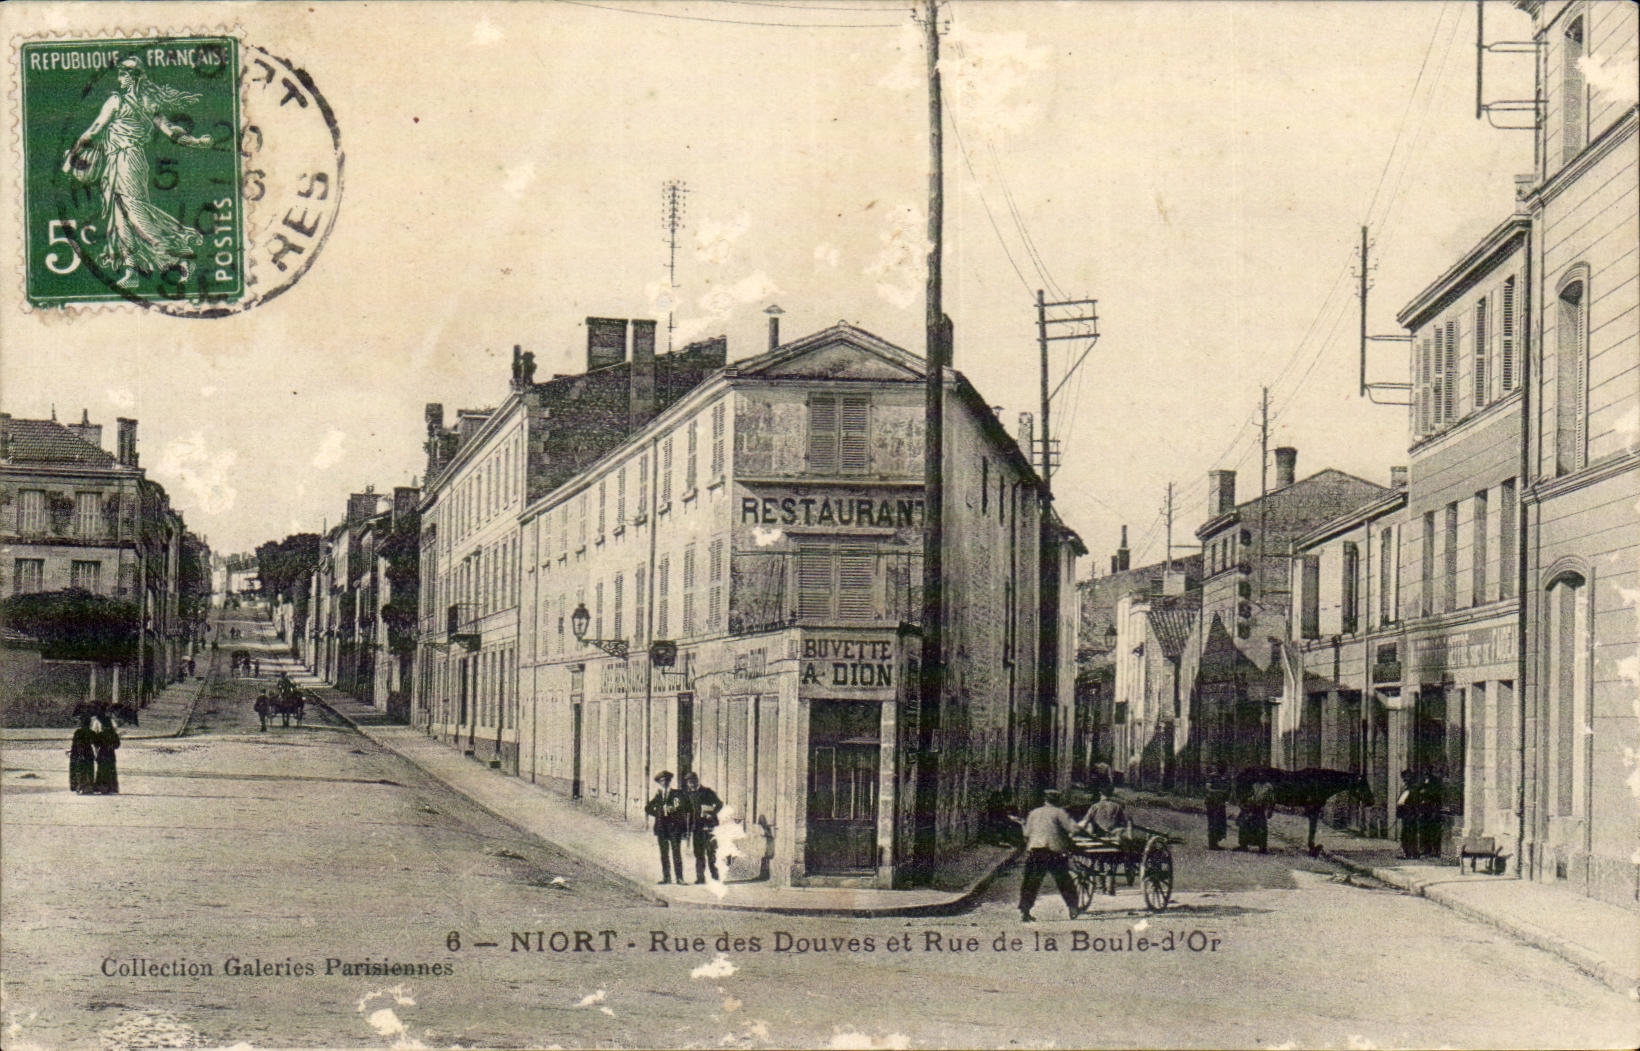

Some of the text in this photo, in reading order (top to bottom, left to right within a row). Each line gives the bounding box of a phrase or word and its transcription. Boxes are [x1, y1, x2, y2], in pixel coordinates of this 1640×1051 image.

[214, 197, 233, 282] POSTES
[803, 638, 892, 660] BUVETTE
[832, 662, 893, 687] DION
